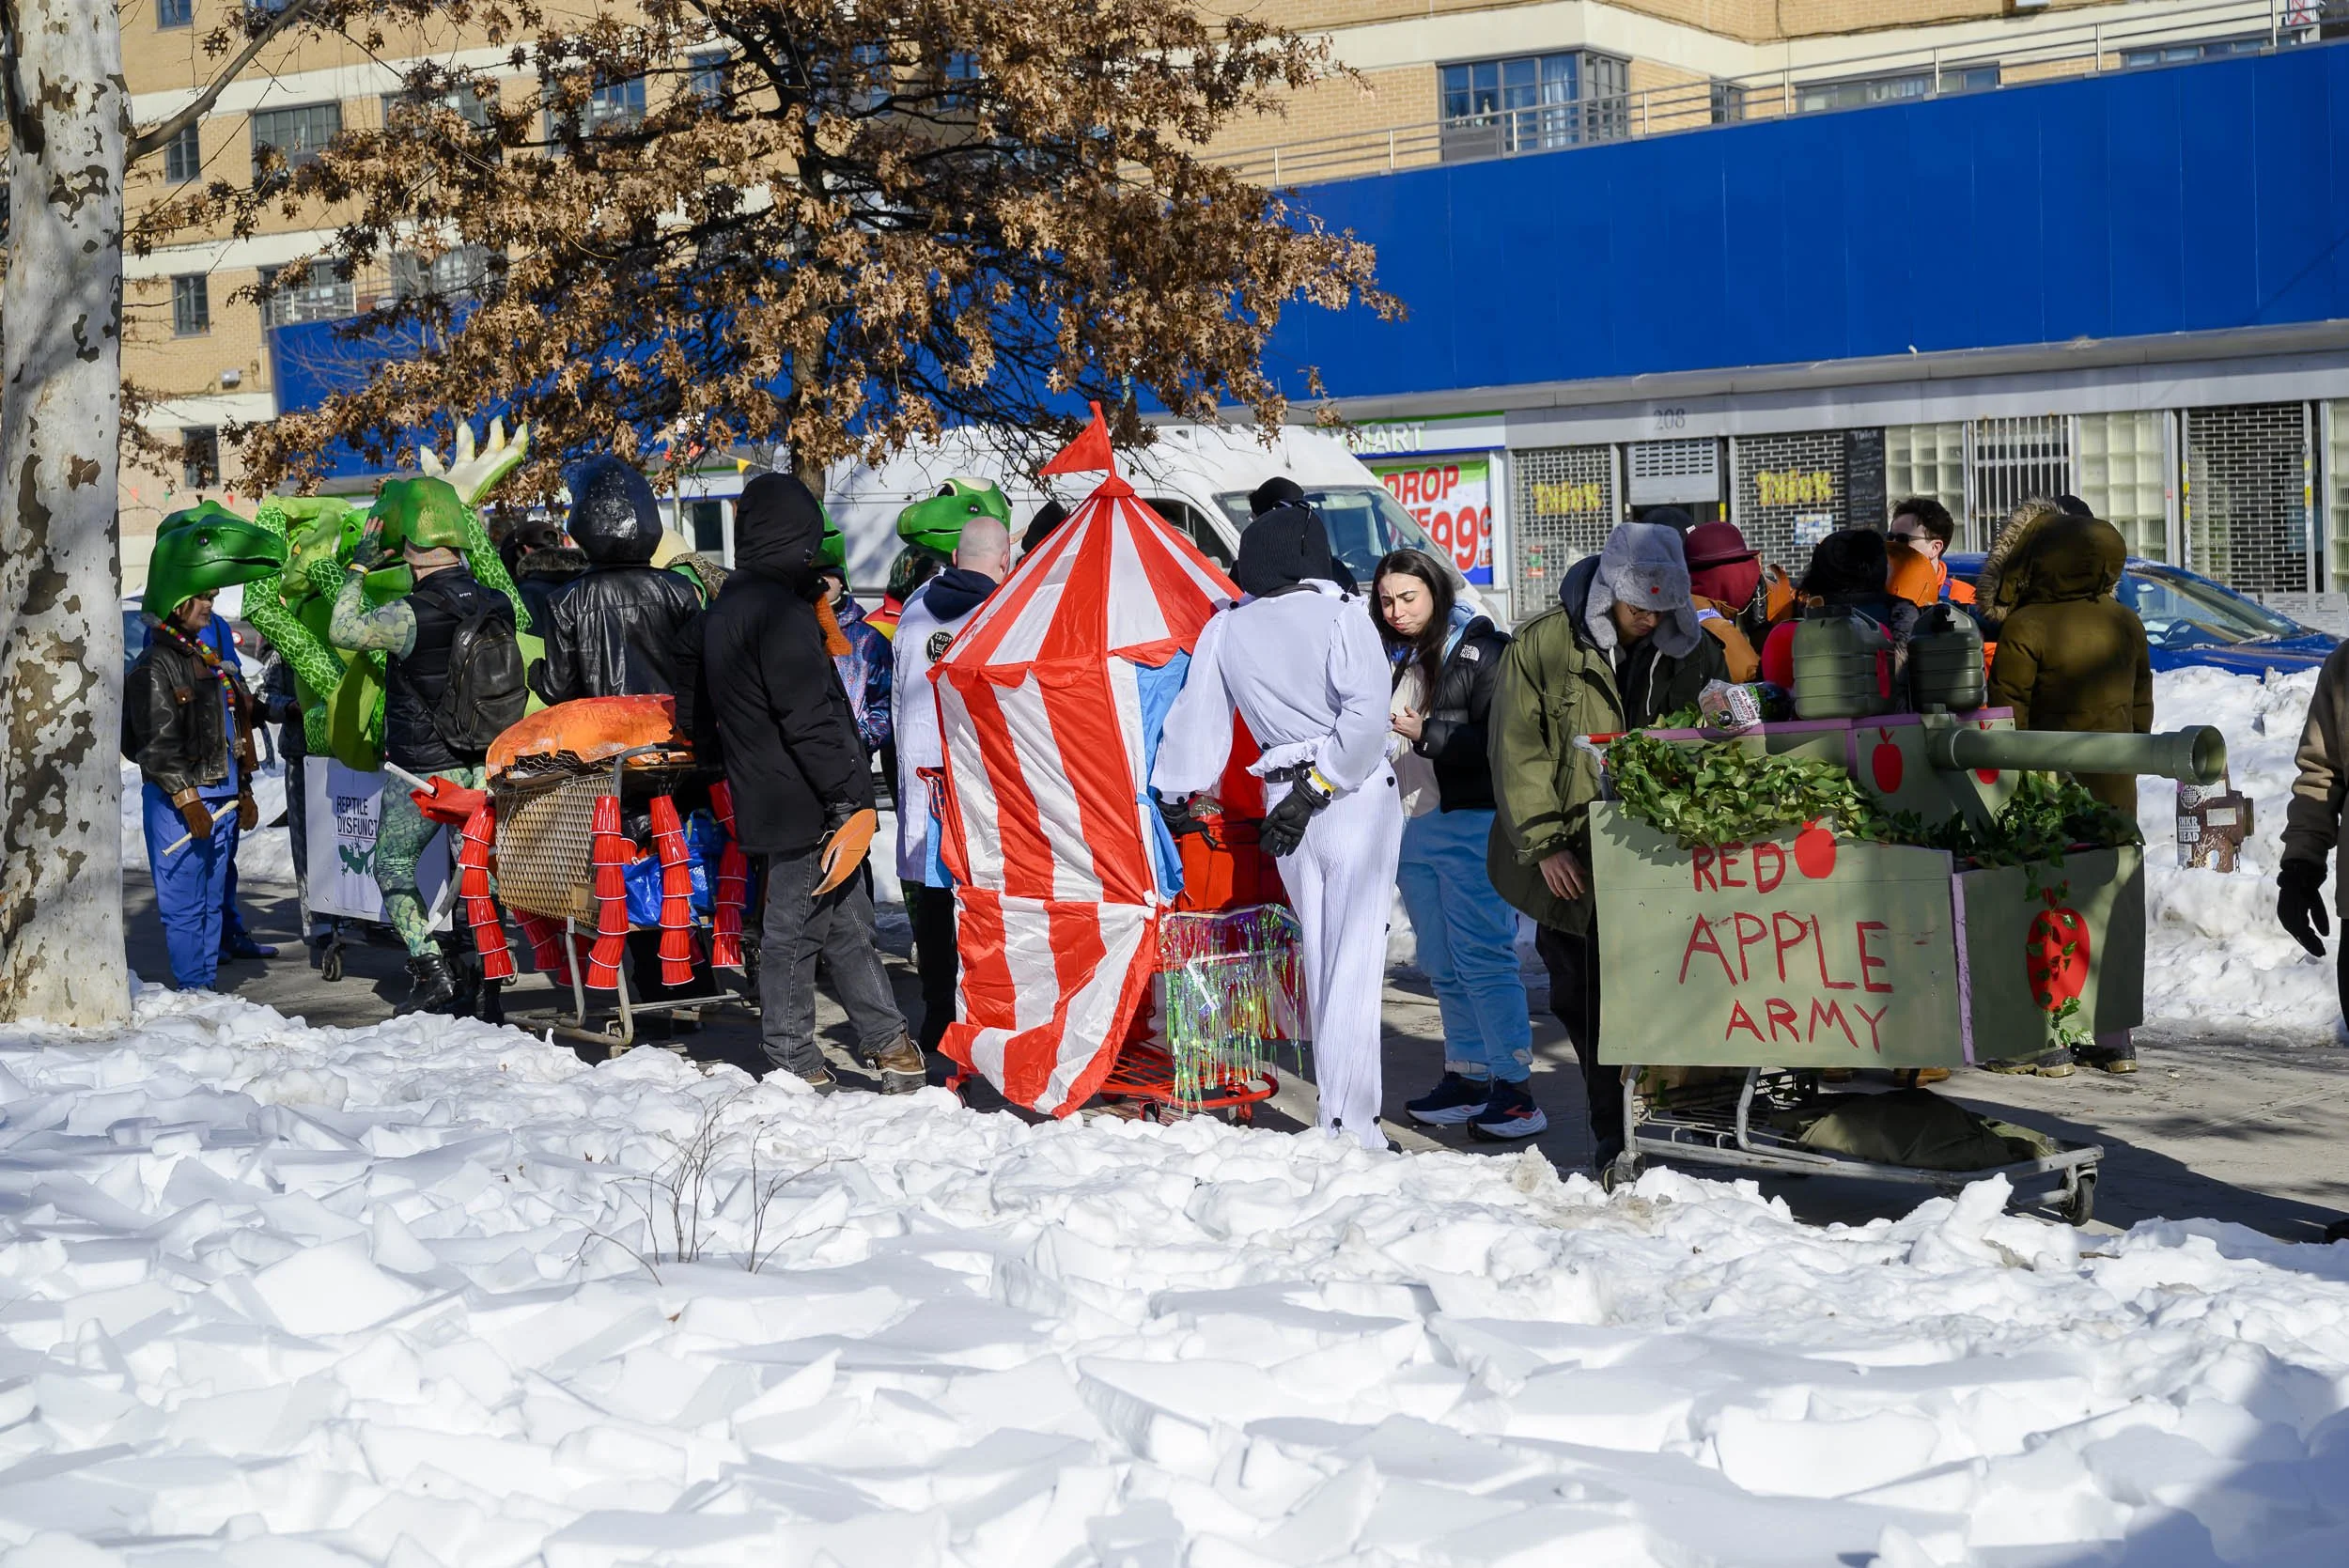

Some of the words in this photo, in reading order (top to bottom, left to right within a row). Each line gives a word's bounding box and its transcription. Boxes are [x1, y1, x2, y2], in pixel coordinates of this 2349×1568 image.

[1347, 421, 1426, 455] MART
[1654, 408, 1687, 430] 208
[1383, 465, 1459, 505] DROP
[336, 796, 368, 815] REPTILE
[1693, 842, 1786, 894] RED
[1679, 910, 1893, 994] APPLE
[1726, 999, 1890, 1054] ARMY
